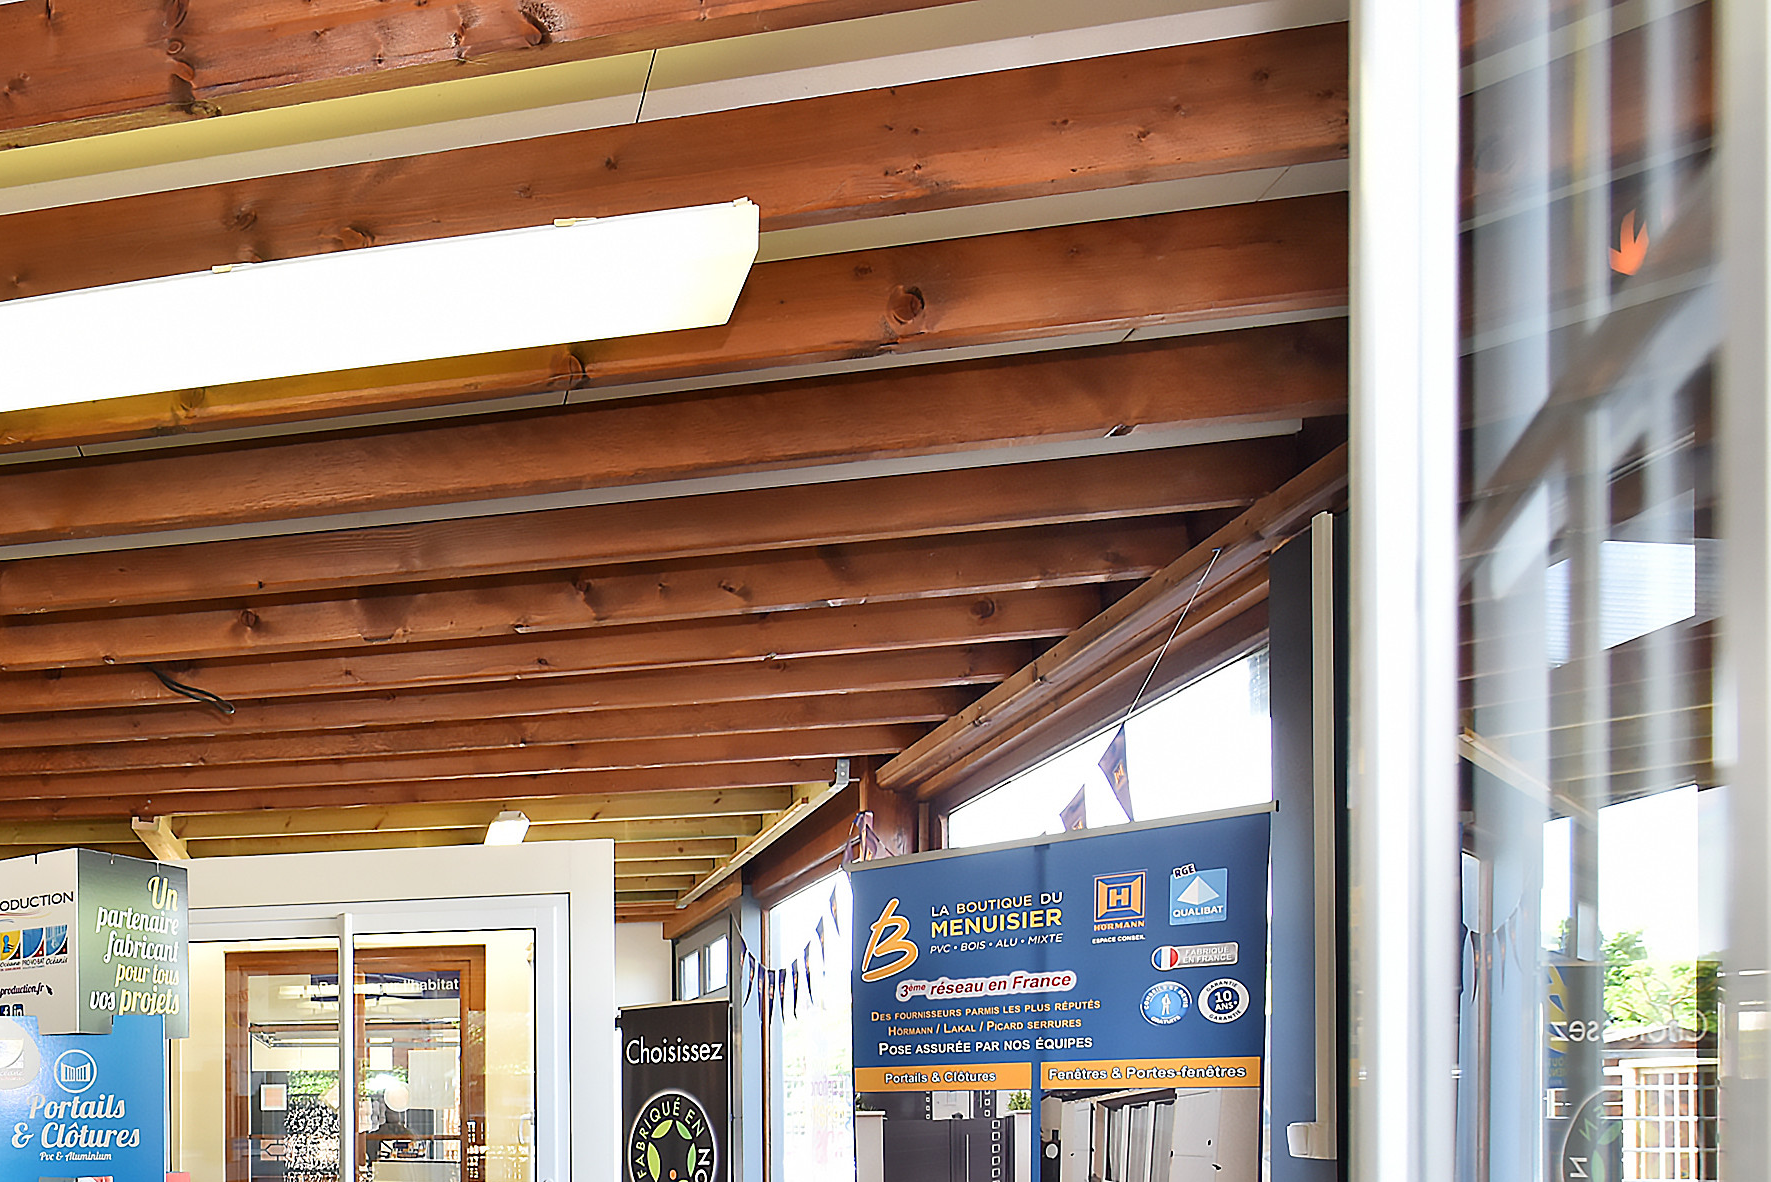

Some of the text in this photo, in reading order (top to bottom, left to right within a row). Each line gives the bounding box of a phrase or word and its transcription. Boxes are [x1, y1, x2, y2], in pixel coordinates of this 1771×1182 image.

[1174, 865, 1195, 878] RGE
[147, 876, 178, 911] Un
[931, 891, 1063, 918] LA BOUTIQUE DU
[95, 906, 179, 936] partenaire
[931, 908, 1062, 939] MENUISIER
[1172, 905, 1223, 918] QUALIBAT
[103, 930, 179, 964] fabricant
[929, 933, 1063, 954] PVC BOIS ALU MIXTE
[1196, 954, 1232, 963] FRANCE
[114, 963, 180, 988] pour tous
[930, 979, 984, 996] réseau
[988, 979, 1007, 992] en
[1012, 974, 1072, 990] France
[89, 985, 180, 1016] vos projets
[1214, 990, 1232, 1002] 10
[626, 1035, 724, 1065] Choisissez
[884, 1068, 997, 1084] Portails & Clôtures
[1047, 1063, 1247, 1081] Fenêtres & Portes-fenêtres
[27, 1093, 126, 1119] Portails
[11, 1121, 140, 1149] & Clôtures
[636, 1097, 706, 1179] FABRIQUÉ EN
[39, 1151, 55, 1162] Pvc
[65, 1151, 112, 1162] Aluminium
